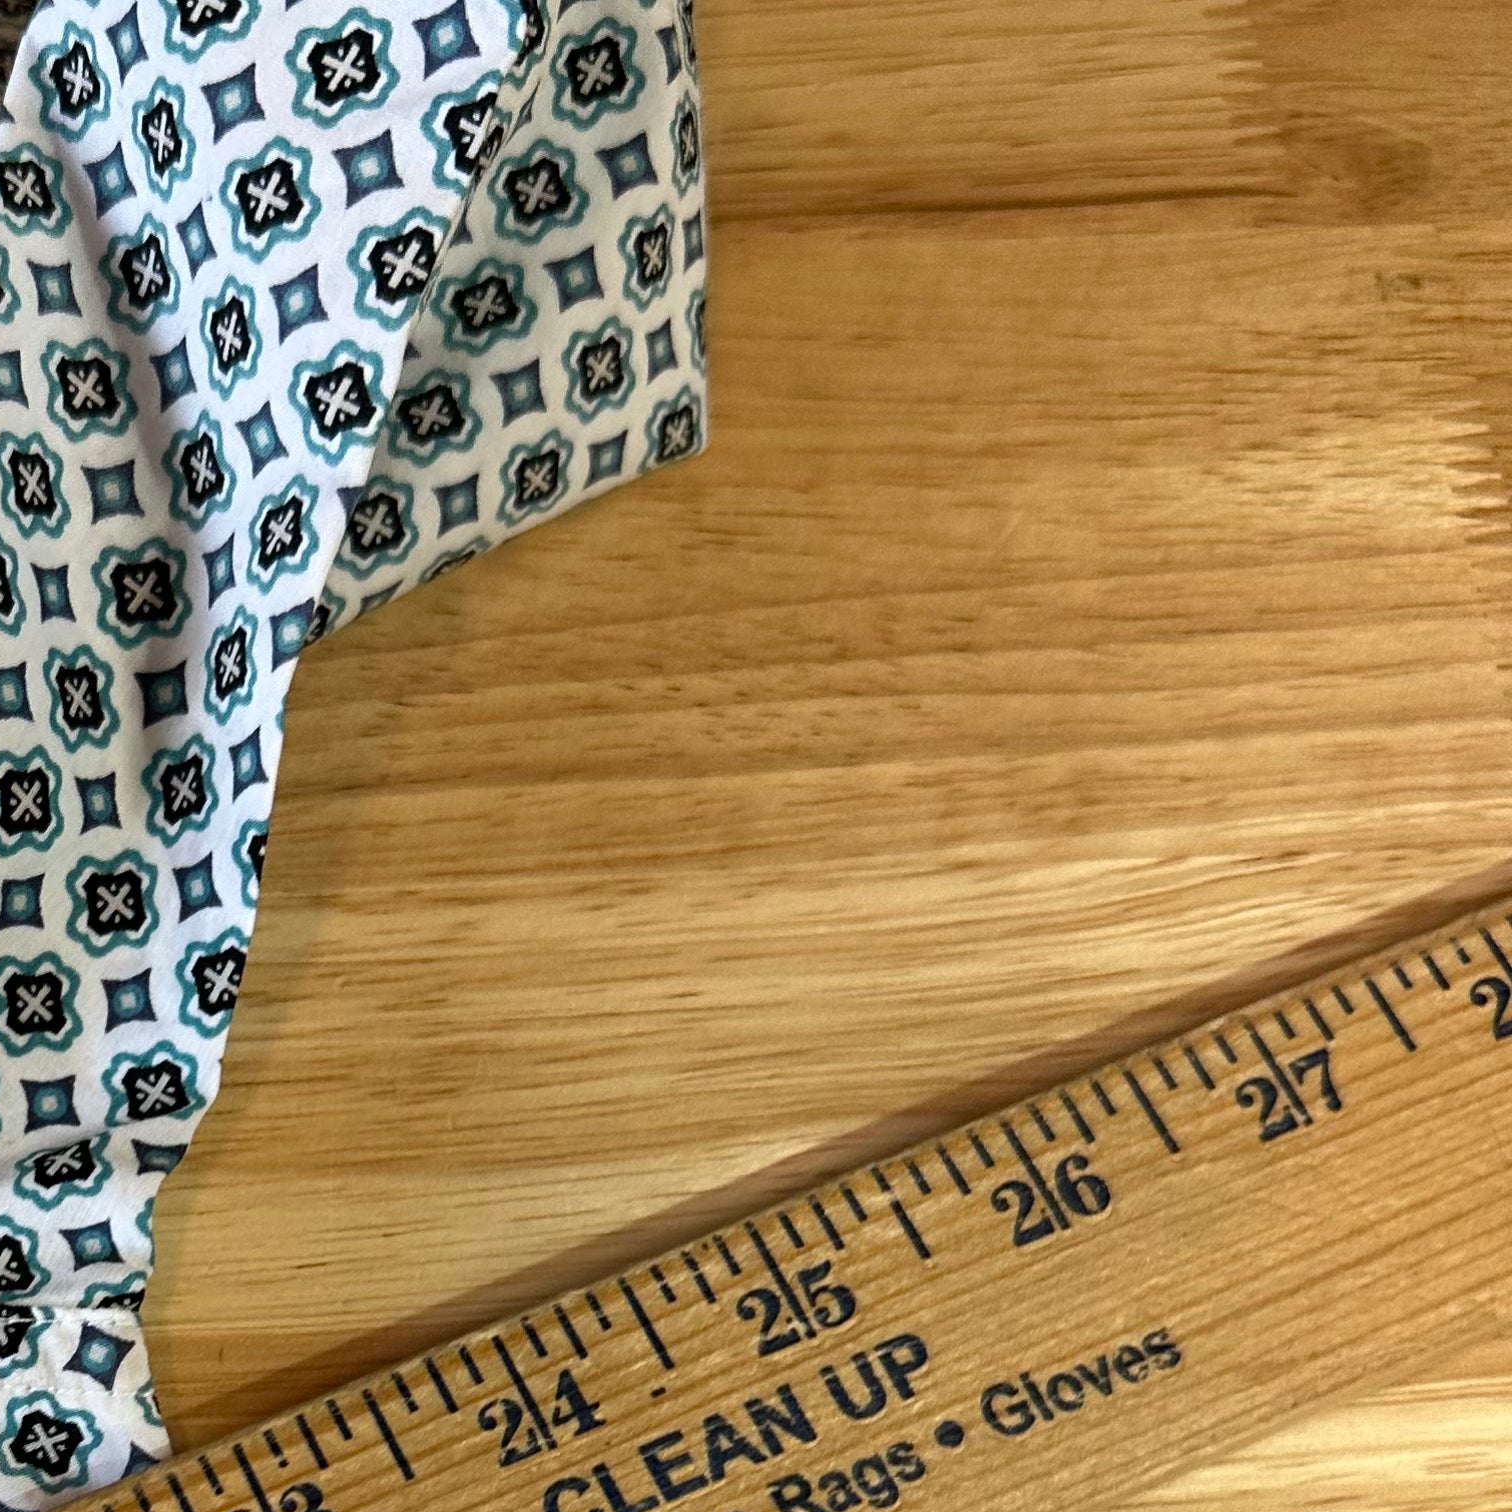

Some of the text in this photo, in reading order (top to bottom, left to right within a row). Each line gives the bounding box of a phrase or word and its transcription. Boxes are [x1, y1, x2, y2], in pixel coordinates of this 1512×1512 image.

[1234, 1047, 1345, 1143] 27
[990, 1153, 1112, 1247] 26
[735, 1260, 858, 1357] 25
[477, 1368, 606, 1467] 24
[820, 1330, 931, 1424] UP
[979, 1324, 1184, 1439] Gloves
